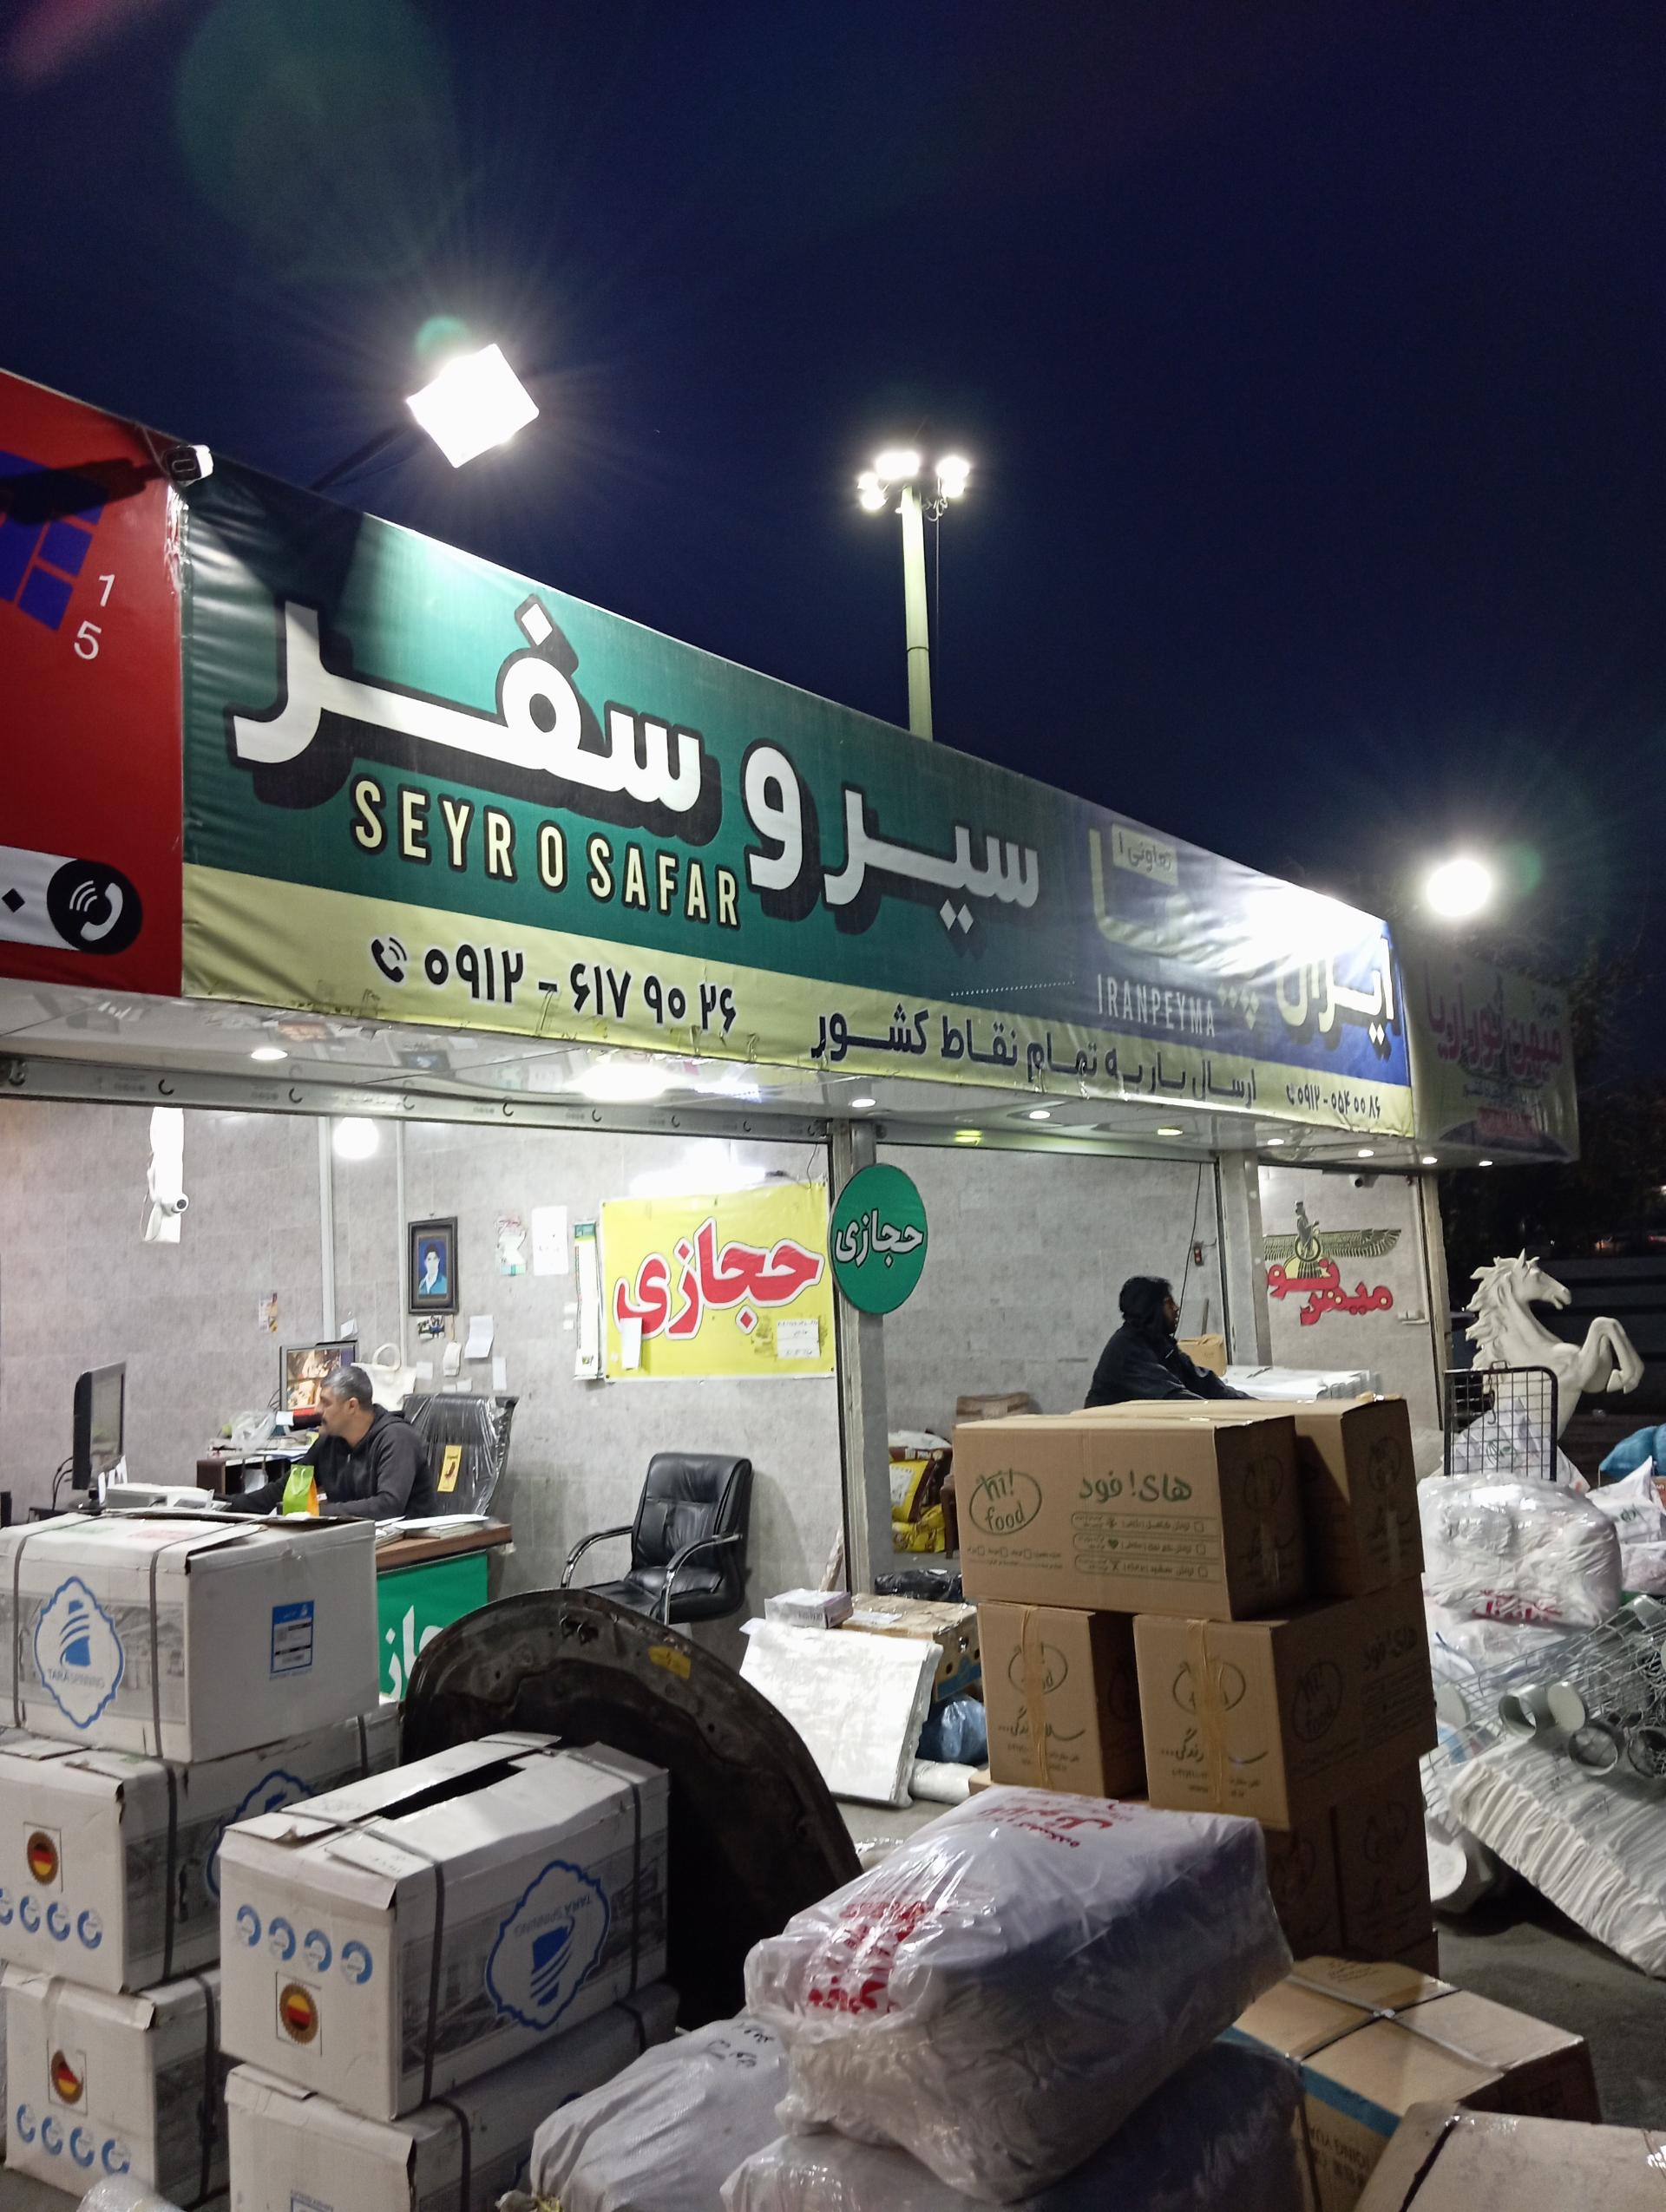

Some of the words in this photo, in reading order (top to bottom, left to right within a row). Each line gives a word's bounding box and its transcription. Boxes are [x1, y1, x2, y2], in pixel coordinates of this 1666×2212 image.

[234, 599, 701, 813] سفر
[744, 746, 804, 891] و
[354, 781, 514, 877] SEYR
[540, 825, 565, 889] O
[588, 838, 740, 927] SAFAR
[824, 789, 1040, 934] سیر
[810, 1002, 929, 1062] کشور
[1097, 973, 1216, 1038] IRANPEYMA
[941, 1015, 1018, 1067] نقاط
[1026, 1031, 1098, 1083] تمام
[1149, 1050, 1186, 1096] بار
[1191, 1058, 1256, 1109] ارسال
[835, 1207, 924, 1269] حجازی
[613, 1216, 825, 1340] حجازی
[978, 1468, 1014, 1502] hi!
[1079, 1469, 1124, 1504] فود
[985, 1500, 1025, 1532] food
